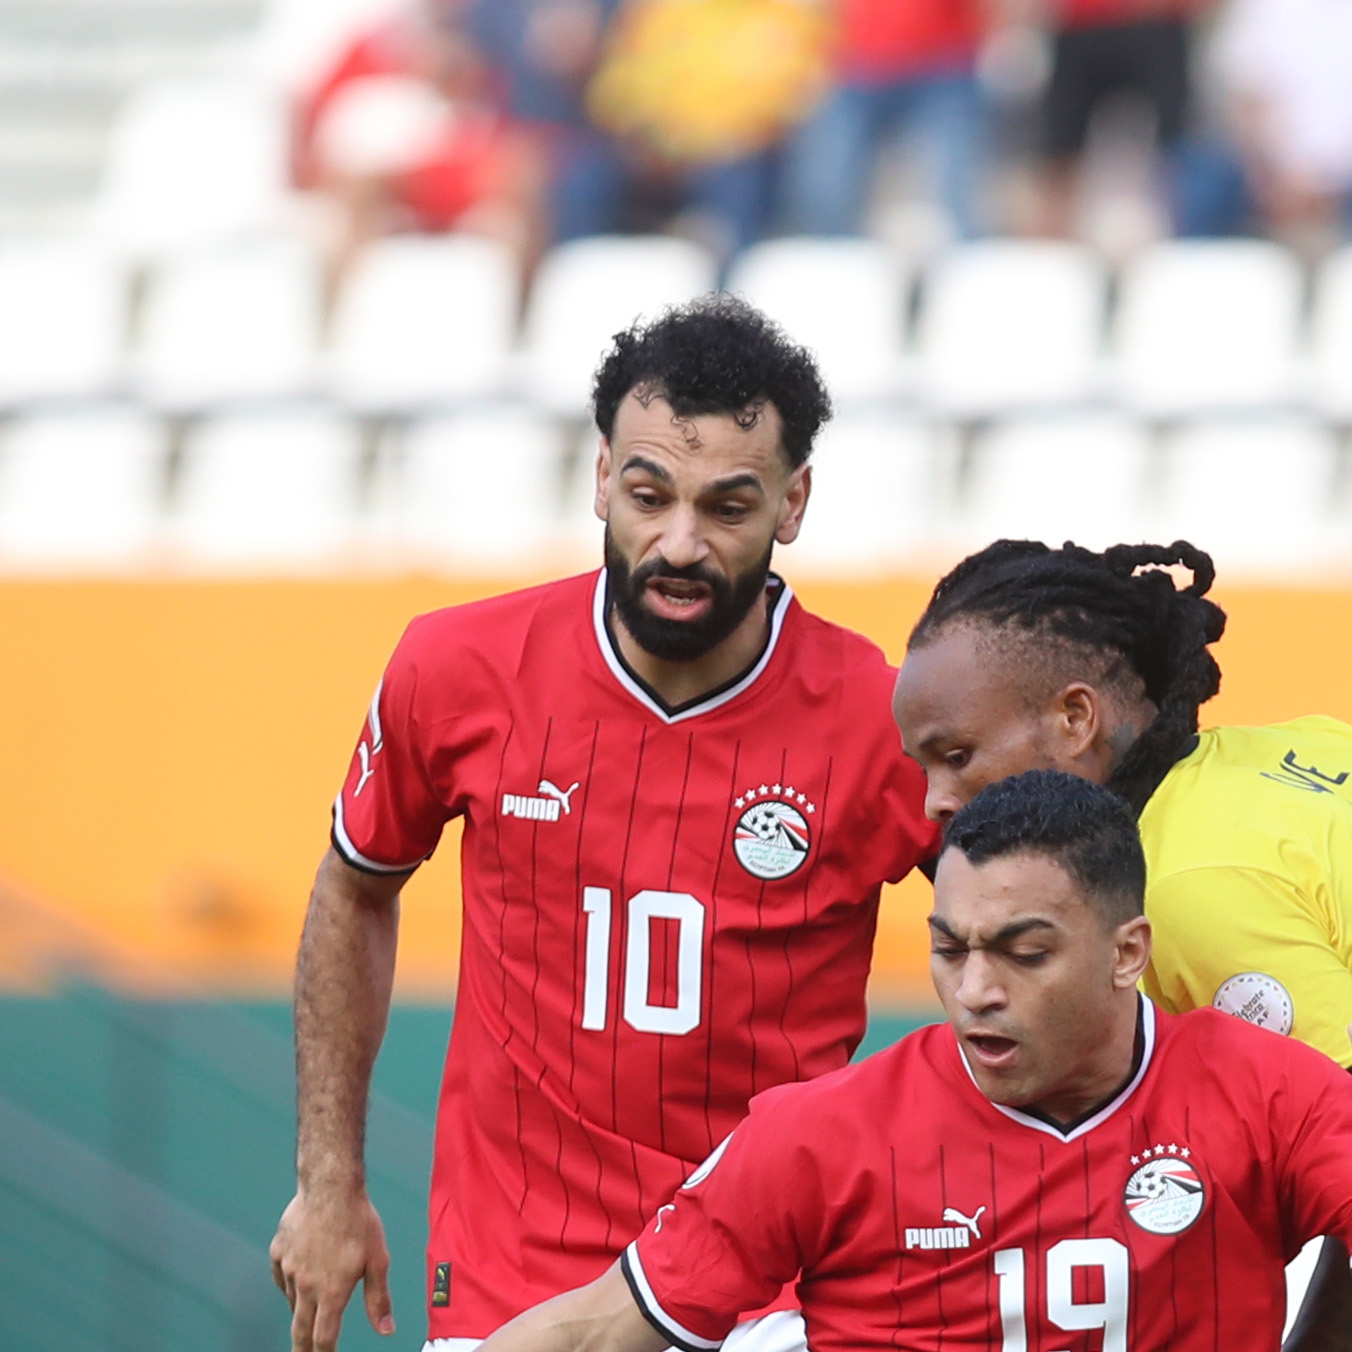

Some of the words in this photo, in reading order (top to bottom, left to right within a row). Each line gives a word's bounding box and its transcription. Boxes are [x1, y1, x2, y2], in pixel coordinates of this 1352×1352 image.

[501, 793, 561, 822] PUMA
[580, 885, 706, 1037] 10
[904, 1226, 970, 1250] PUMA
